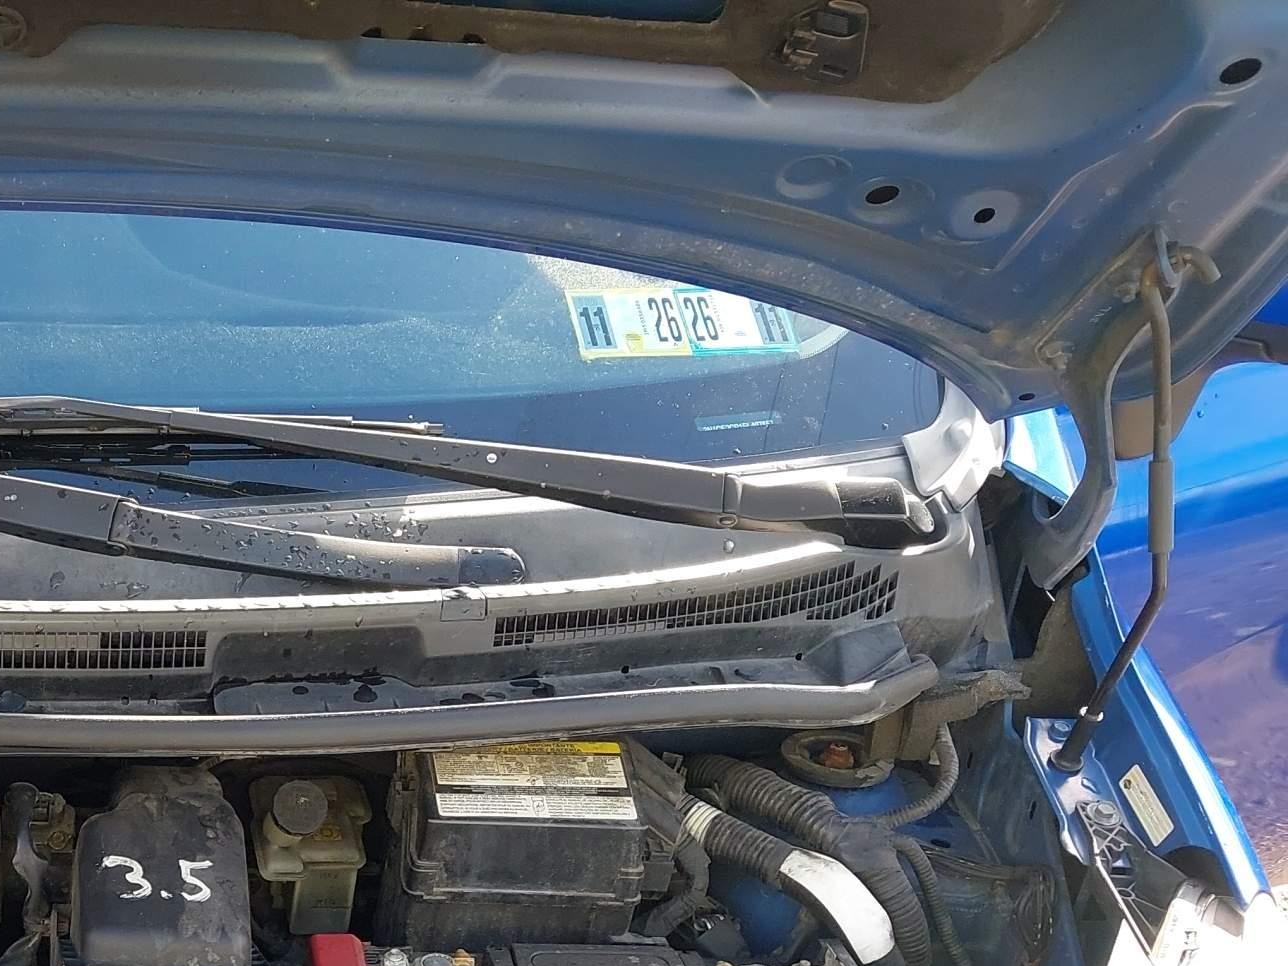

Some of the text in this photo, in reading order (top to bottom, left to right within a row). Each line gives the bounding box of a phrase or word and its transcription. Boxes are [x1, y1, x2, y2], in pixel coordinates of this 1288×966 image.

[579, 306, 612, 347] 11
[647, 297, 683, 343] 26
[683, 296, 720, 342] 26
[101, 855, 214, 902] 3.5
